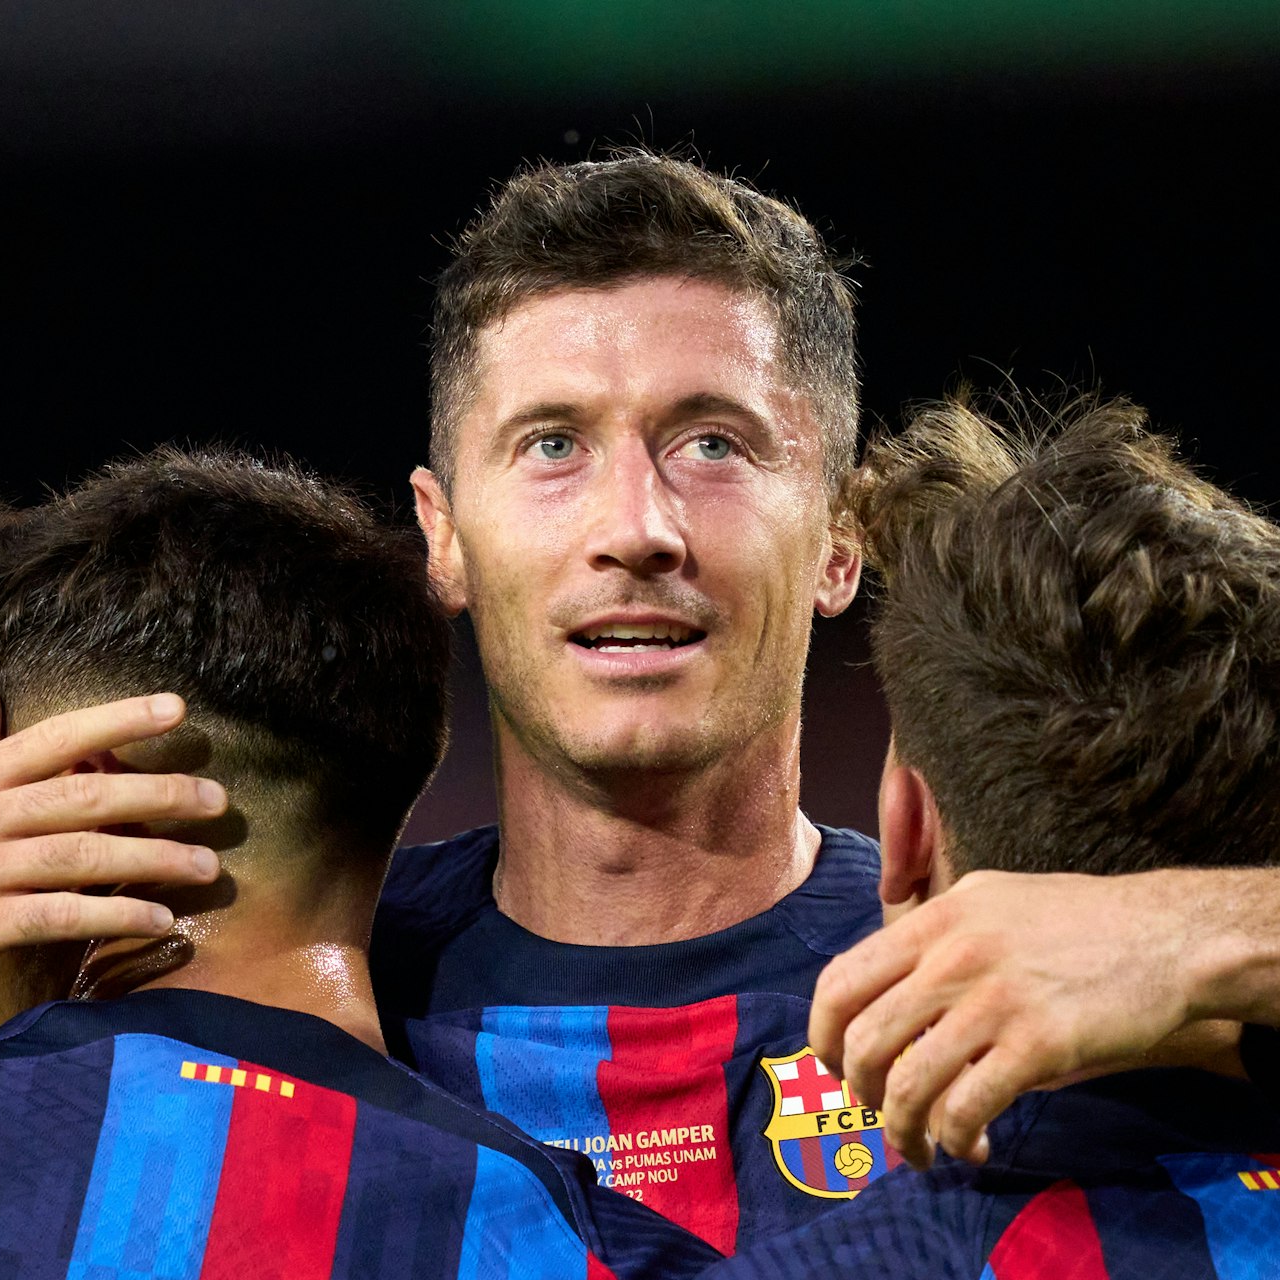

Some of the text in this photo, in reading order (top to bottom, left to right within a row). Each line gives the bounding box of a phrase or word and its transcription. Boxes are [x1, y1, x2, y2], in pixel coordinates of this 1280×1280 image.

[816, 1108, 878, 1133] FCB
[582, 1135, 633, 1155] JOAN
[636, 1124, 716, 1150] GAMPER
[608, 1159, 623, 1170] vs
[625, 1153, 672, 1169] PUMAS
[673, 1147, 717, 1164] UNAM
[605, 1171, 646, 1188] CAMP
[648, 1168, 678, 1184] NOU
